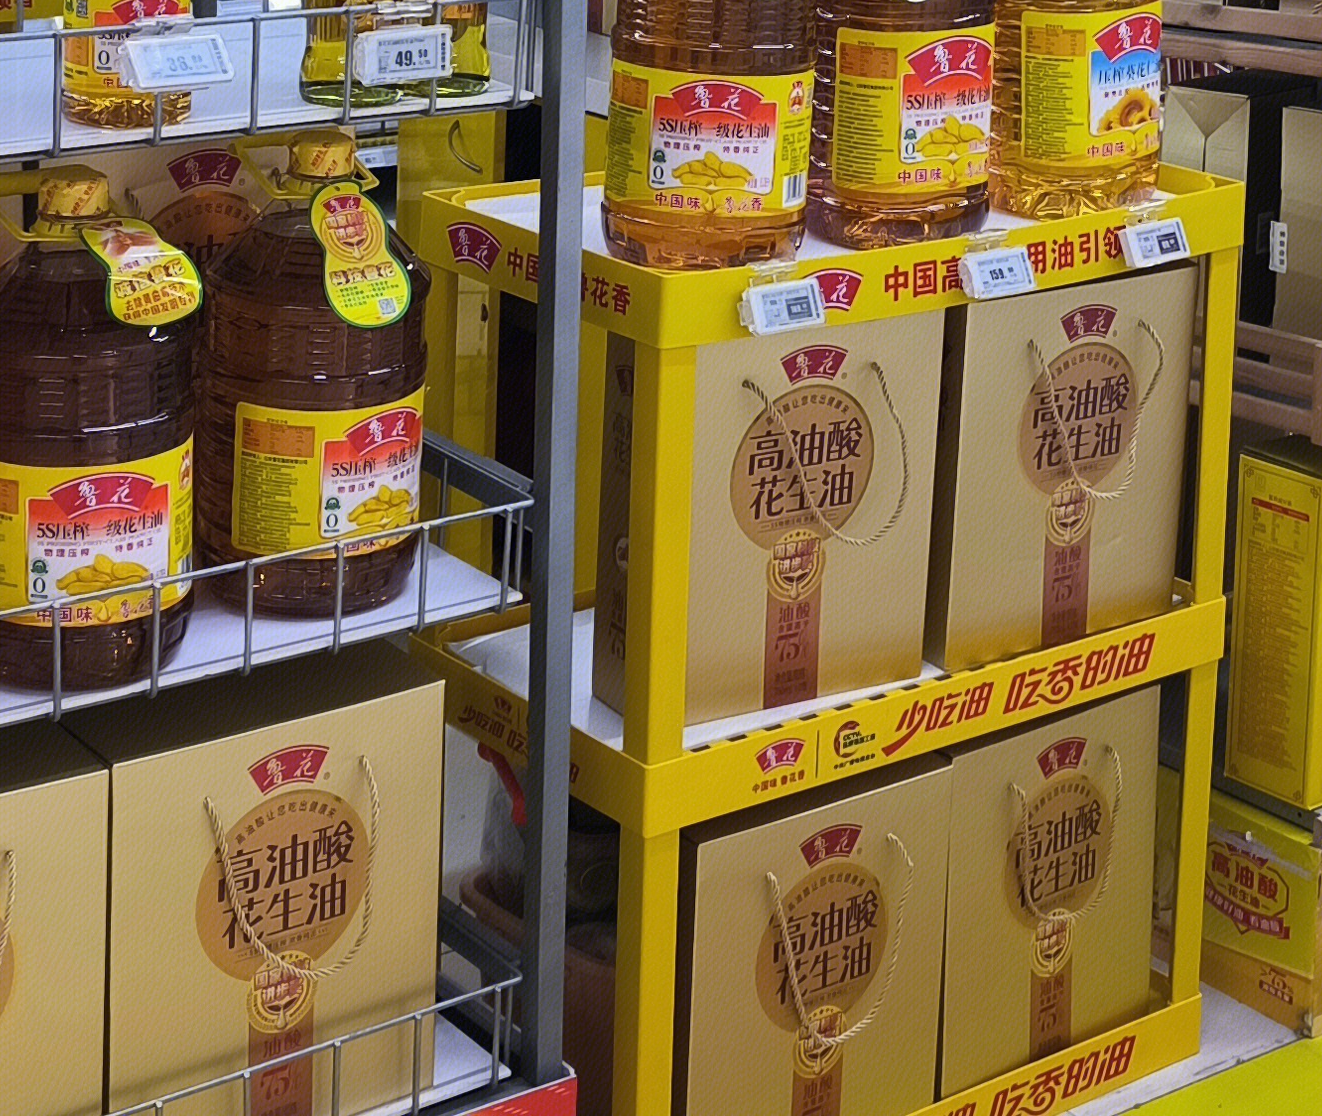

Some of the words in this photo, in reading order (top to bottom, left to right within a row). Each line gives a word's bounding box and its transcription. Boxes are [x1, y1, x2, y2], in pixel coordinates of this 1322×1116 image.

[653, 190, 702, 213] 中国味
[1031, 375, 1131, 430] 高油酸
[747, 417, 863, 475] 高油酸
[1033, 418, 1123, 470] 花生油
[749, 464, 856, 521] 花生油
[881, 680, 995, 757] 少吃油
[1003, 632, 1157, 714] 吃香的油
[218, 819, 355, 901] 高油酸
[1210, 850, 1279, 903] 高油酸
[222, 872, 349, 954] 花生油
